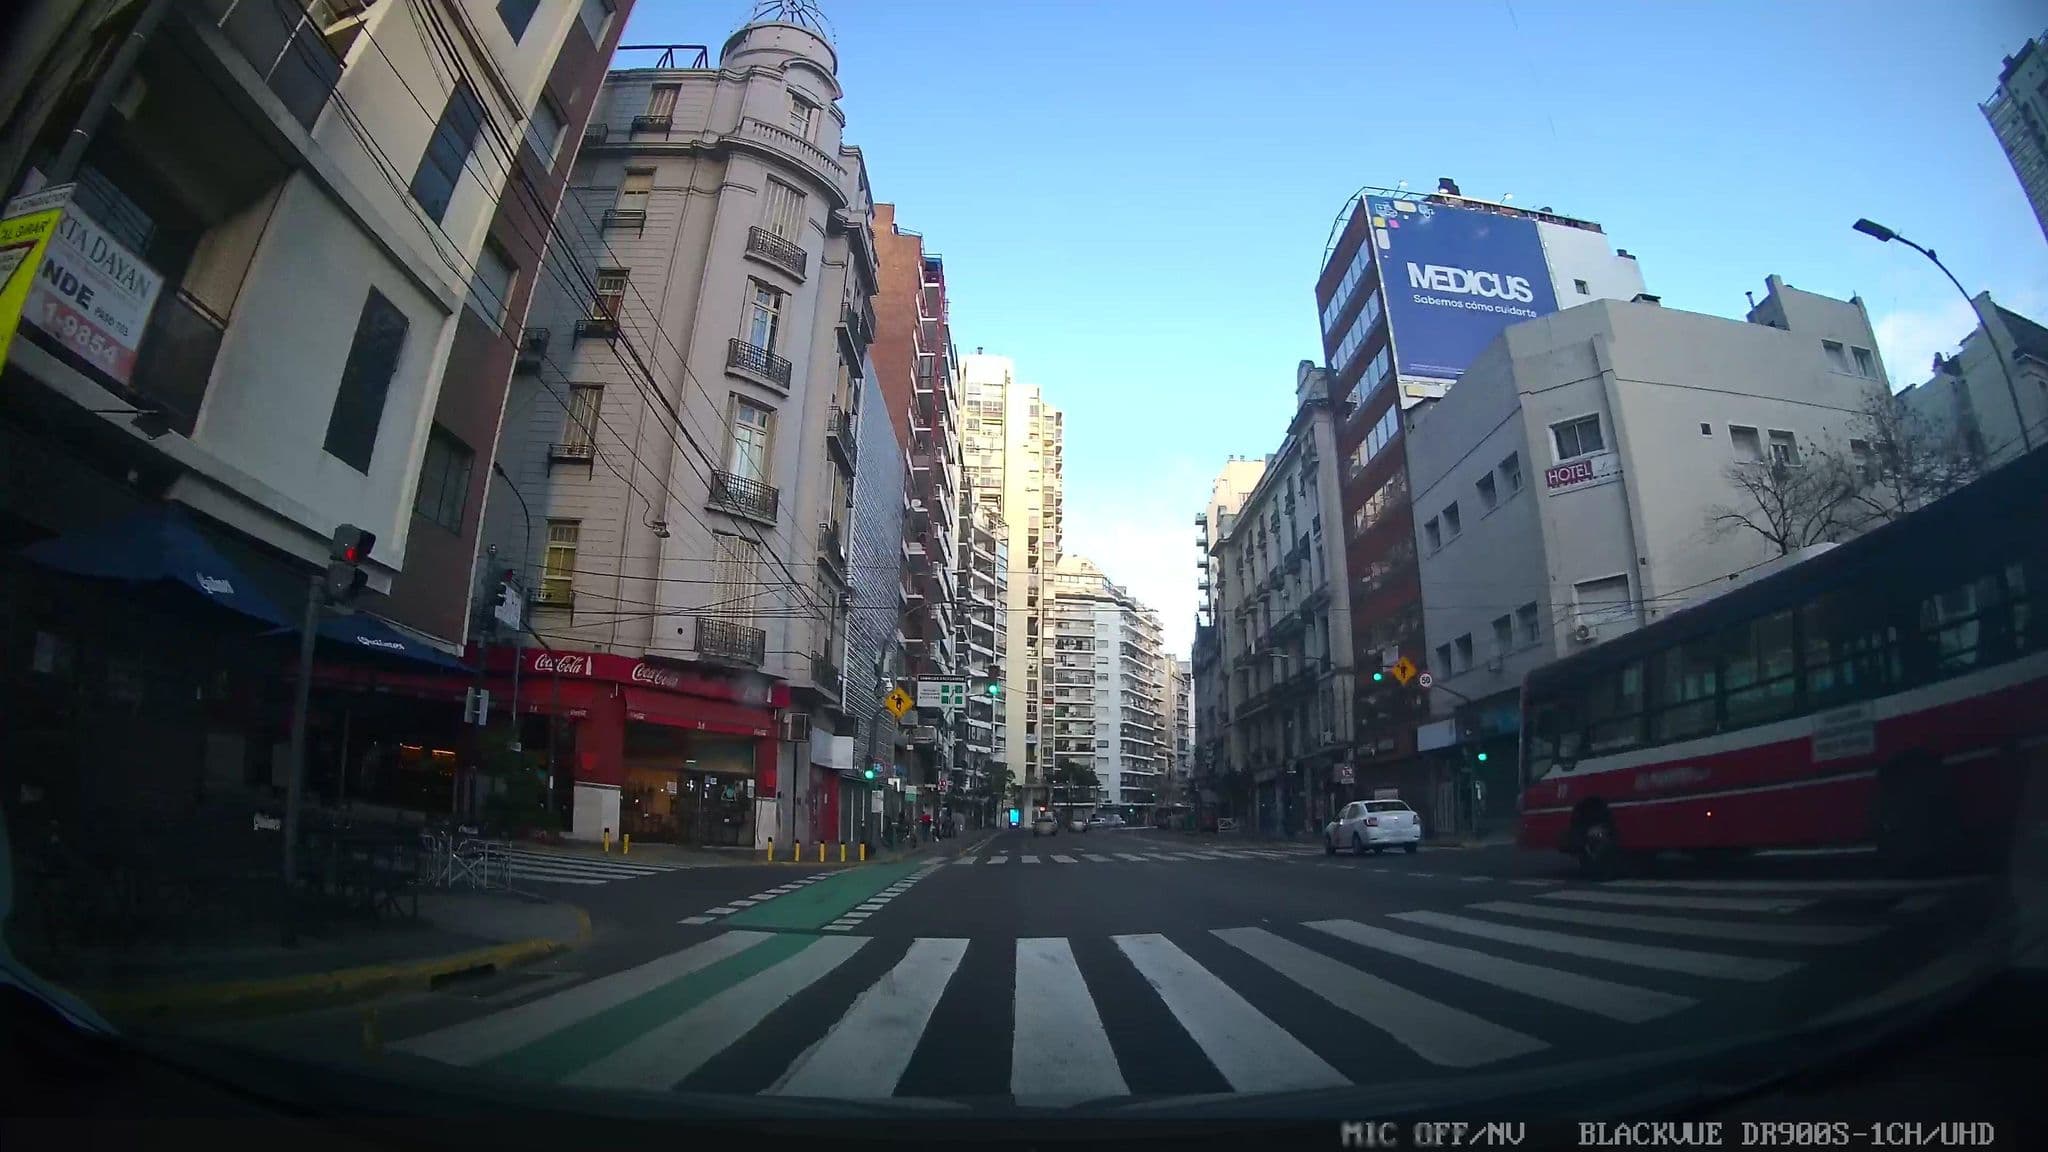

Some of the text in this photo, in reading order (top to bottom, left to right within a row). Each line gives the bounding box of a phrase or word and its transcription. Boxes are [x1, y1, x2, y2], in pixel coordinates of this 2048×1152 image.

[89, 235, 152, 299] DAYAN
[1407, 262, 1534, 303] MEDICUS
[1413, 294, 1537, 319] Sabemos cómo cuidarte
[1548, 462, 1592, 486] HOTEL
